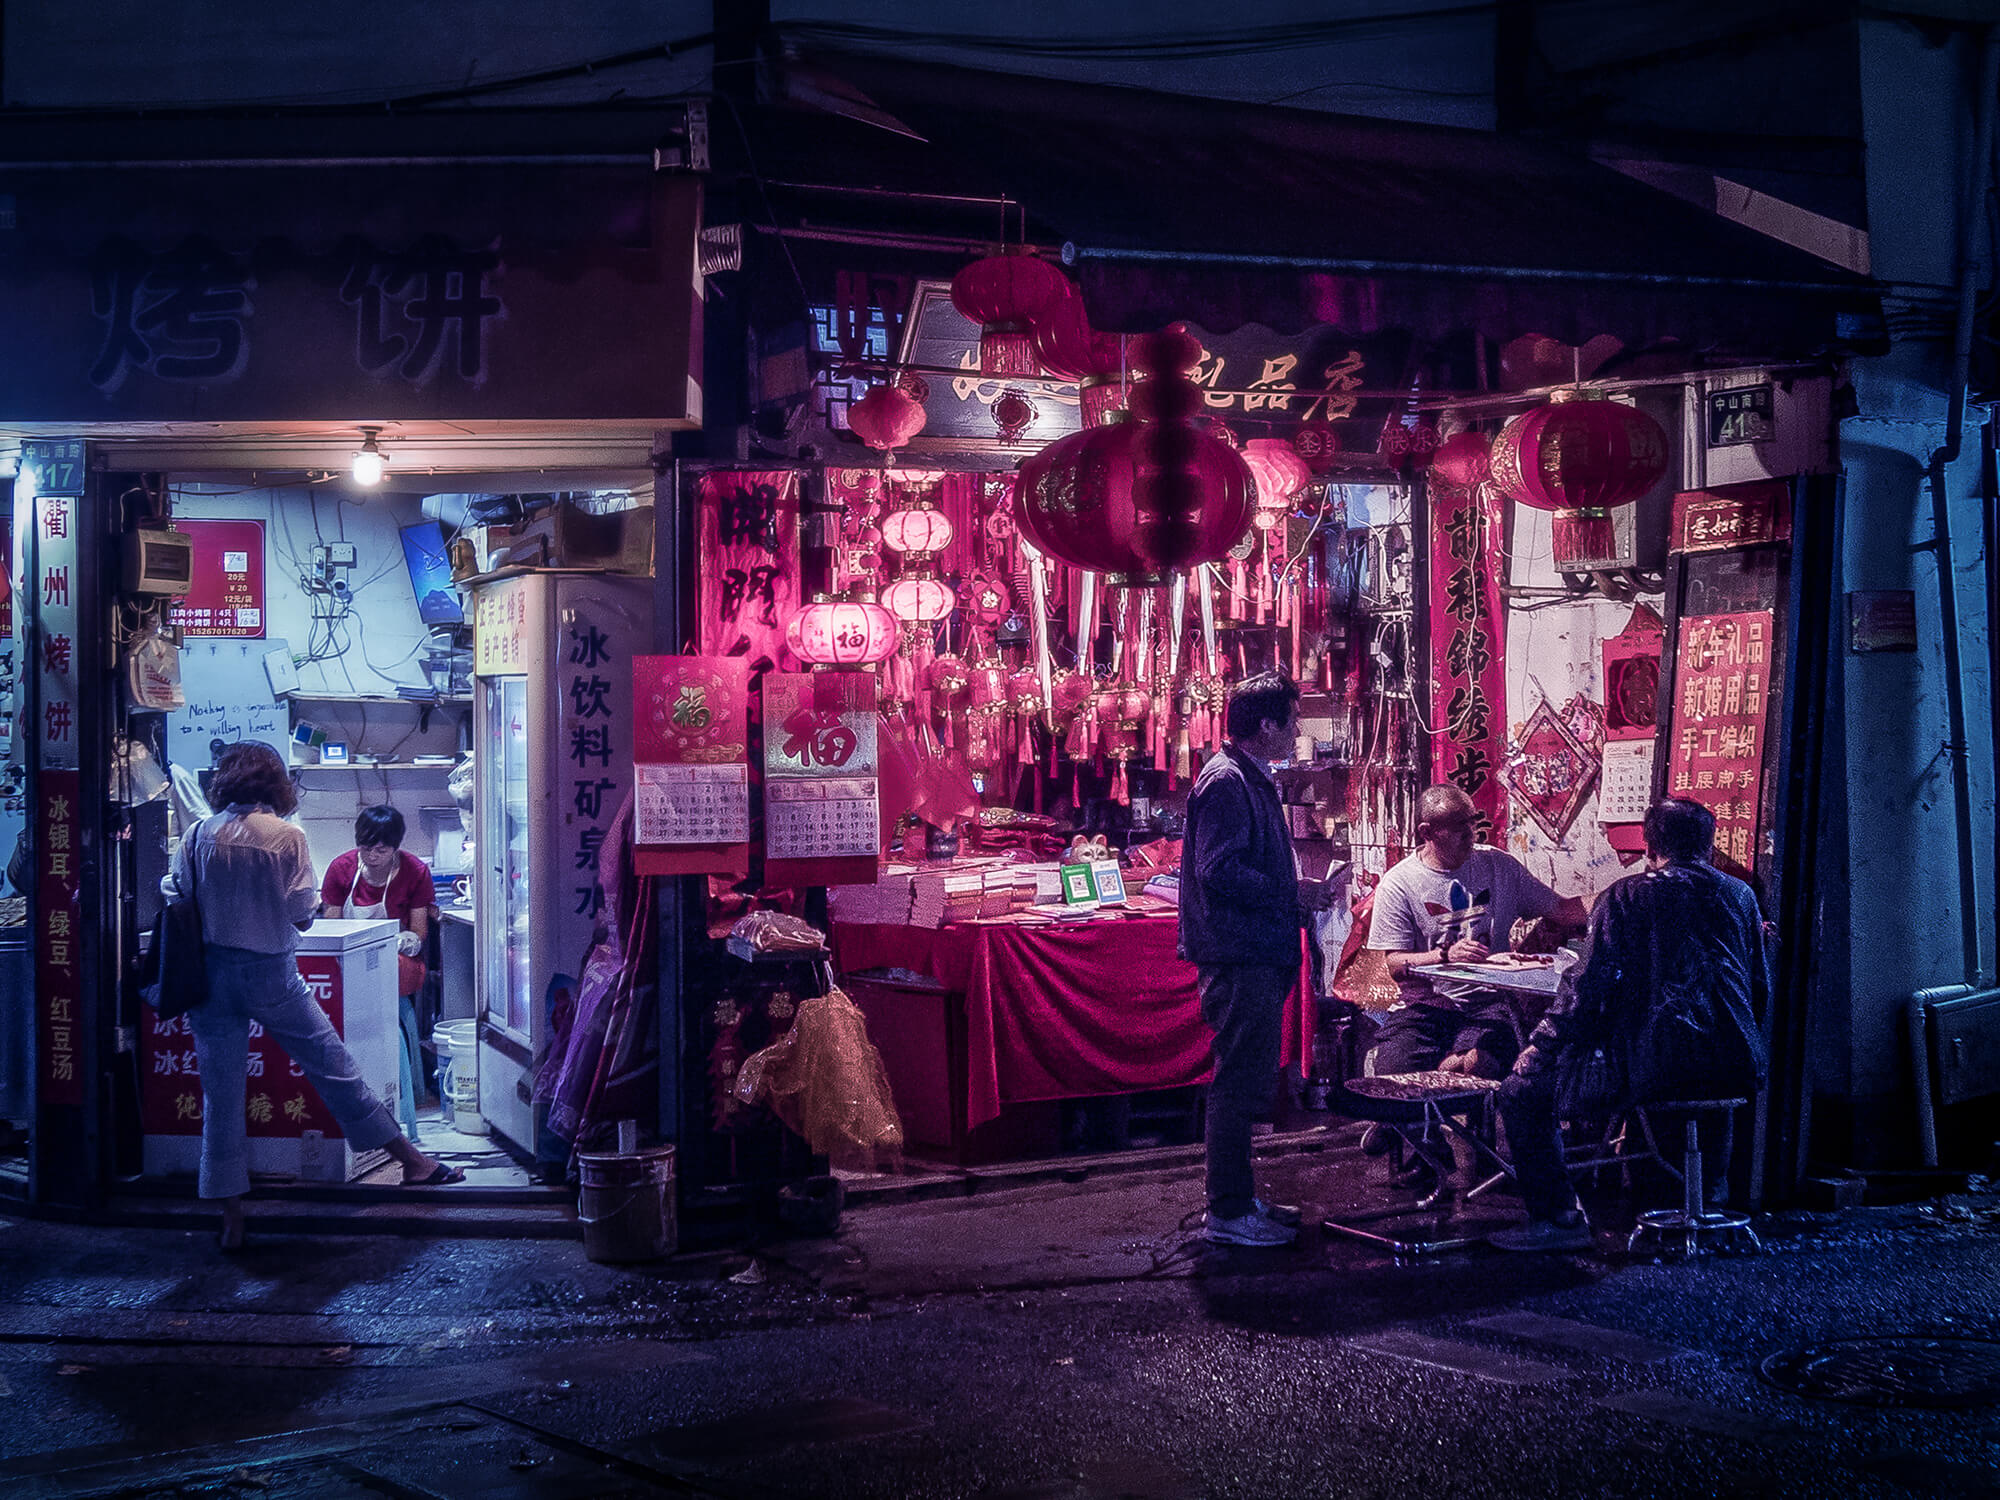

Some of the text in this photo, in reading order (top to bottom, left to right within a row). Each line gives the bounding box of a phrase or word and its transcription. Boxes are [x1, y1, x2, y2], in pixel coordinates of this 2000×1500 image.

[88, 237, 506, 392] 烤饼
[26, 444, 80, 459] 中山南路
[43, 499, 71, 742] 衢州烤饼
[1686, 622, 1763, 668] 新年礼品
[673, 685, 711, 729] 福
[1683, 673, 1761, 718] 新婚用品
[180, 725, 192, 735] to
[210, 720, 242, 740] willing
[249, 719, 276, 734] heart
[1679, 724, 1757, 762] 手工编织
[569, 626, 617, 920] 冰饮料矿泉水
[306, 974, 333, 999] 元
